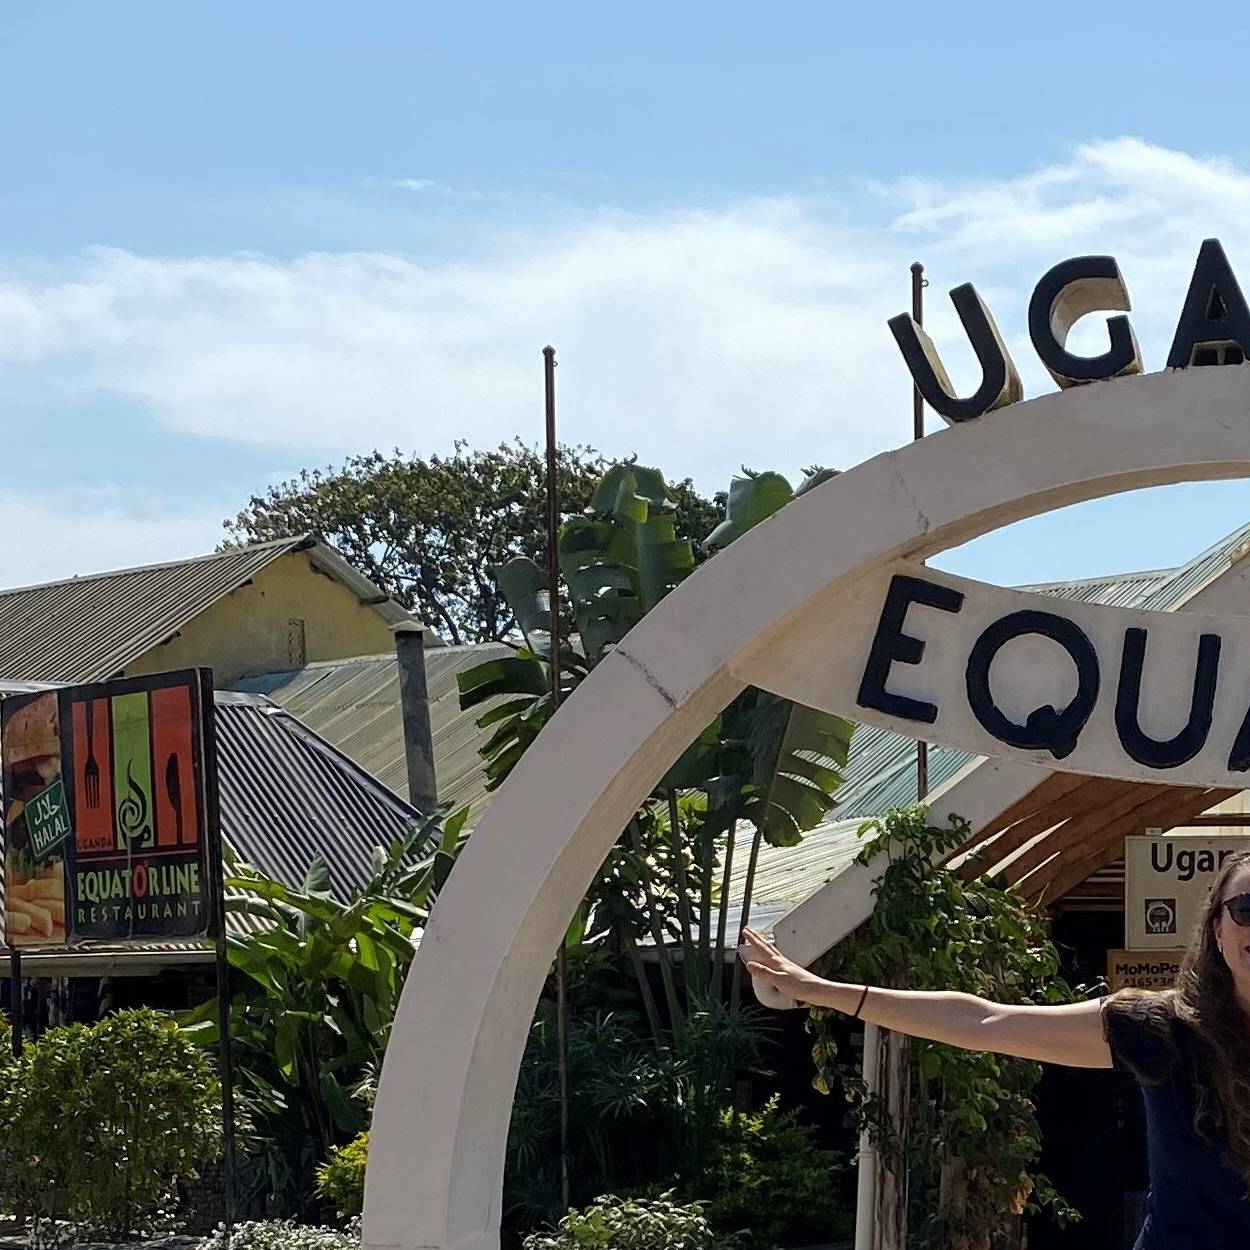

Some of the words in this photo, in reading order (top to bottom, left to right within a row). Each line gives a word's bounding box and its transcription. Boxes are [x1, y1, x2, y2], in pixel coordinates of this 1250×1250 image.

[33, 815, 68, 850] HALAL
[77, 839, 114, 850] UGANDA
[77, 863, 200, 903] EQUATORLINE
[78, 900, 201, 923] RESTAURANT
